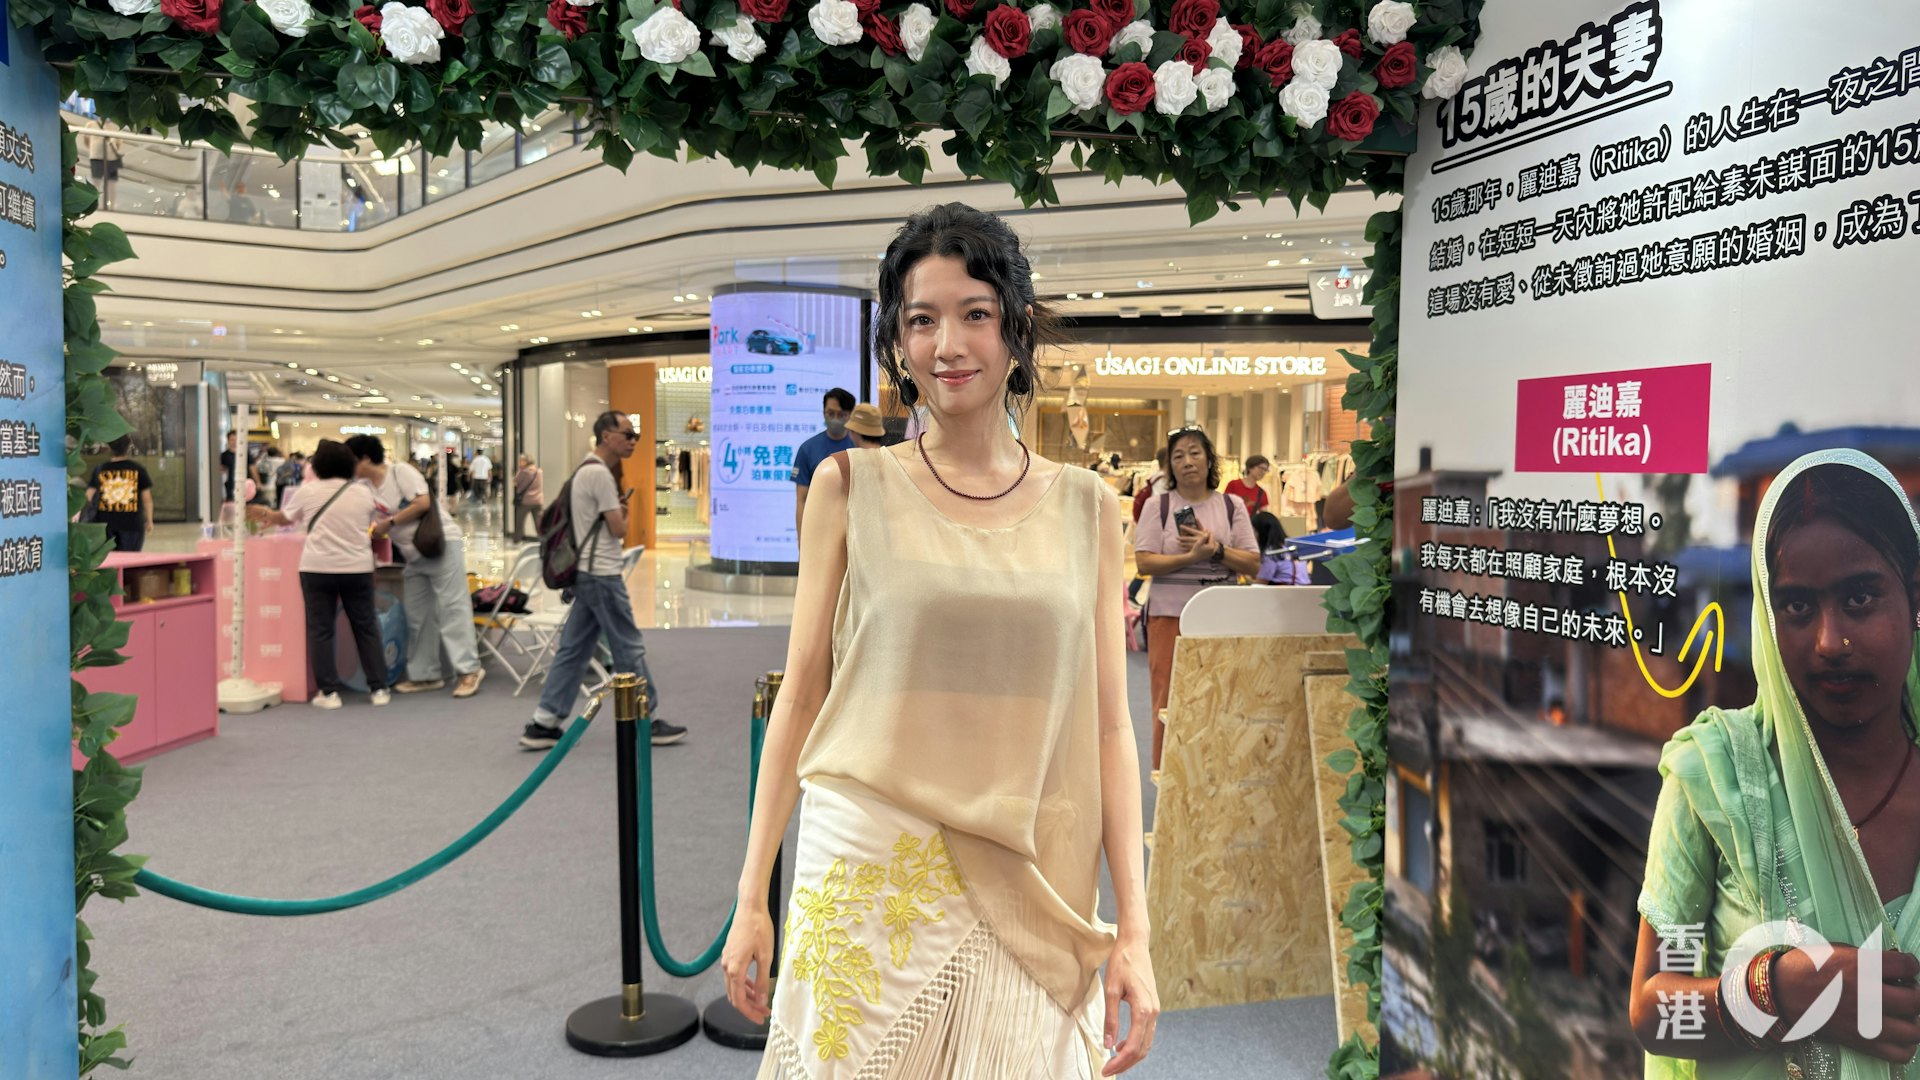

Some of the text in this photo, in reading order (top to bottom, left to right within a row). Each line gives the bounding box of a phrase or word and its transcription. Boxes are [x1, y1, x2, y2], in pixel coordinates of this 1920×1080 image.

[1438, 3, 1661, 144] 15歲的夫妻
[1429, 122, 1920, 271] 結婚，在短短一天內將她許配給素未謀面的15
[658, 366, 696, 384] USAGI
[1095, 355, 1327, 375] USAGI ONLINE STORE
[1562, 381, 1642, 420] 麗迪嘉
[723, 442, 738, 475] 4
[1552, 424, 1652, 464] (Ritika)
[1, 482, 41, 515] 被困在
[0, 539, 42, 573] 的教育
[1420, 542, 1678, 598] 我每天都在照顧家庭，根本沒
[1418, 588, 1665, 654] 有機會去想像自己的未來。」
